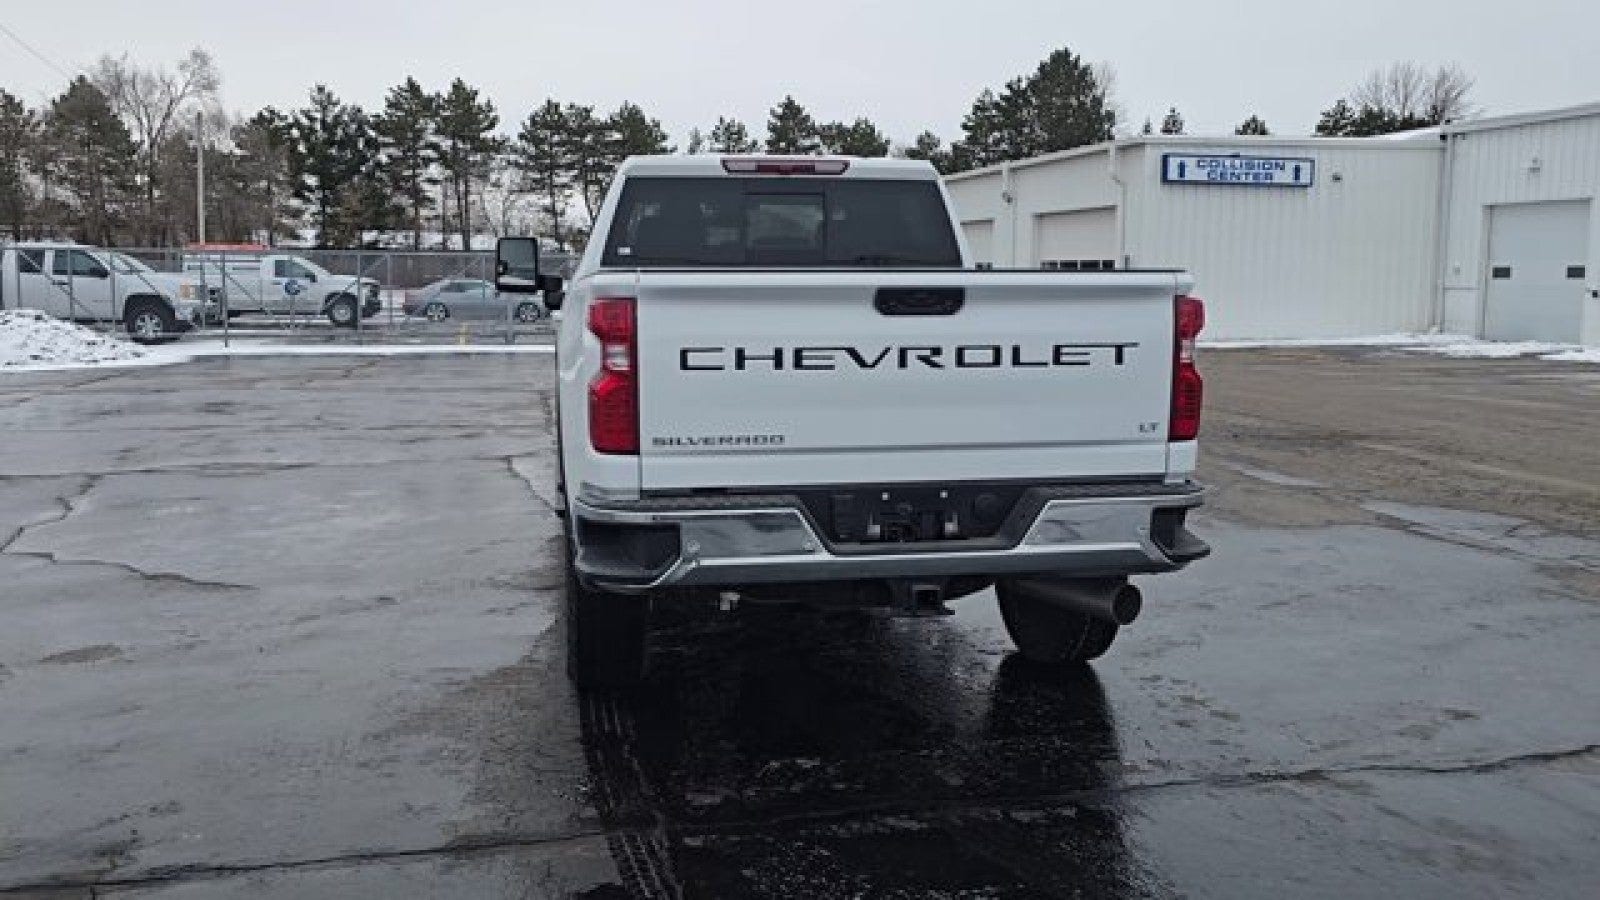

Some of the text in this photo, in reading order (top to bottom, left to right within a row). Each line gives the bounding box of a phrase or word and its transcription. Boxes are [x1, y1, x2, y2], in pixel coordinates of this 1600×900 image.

[1197, 159, 1286, 171] COLLISION
[1207, 170, 1274, 181] CENTER
[679, 342, 1140, 371] CHEVROLET
[1139, 422, 1160, 433] LT
[651, 434, 786, 446] SILVERADO
